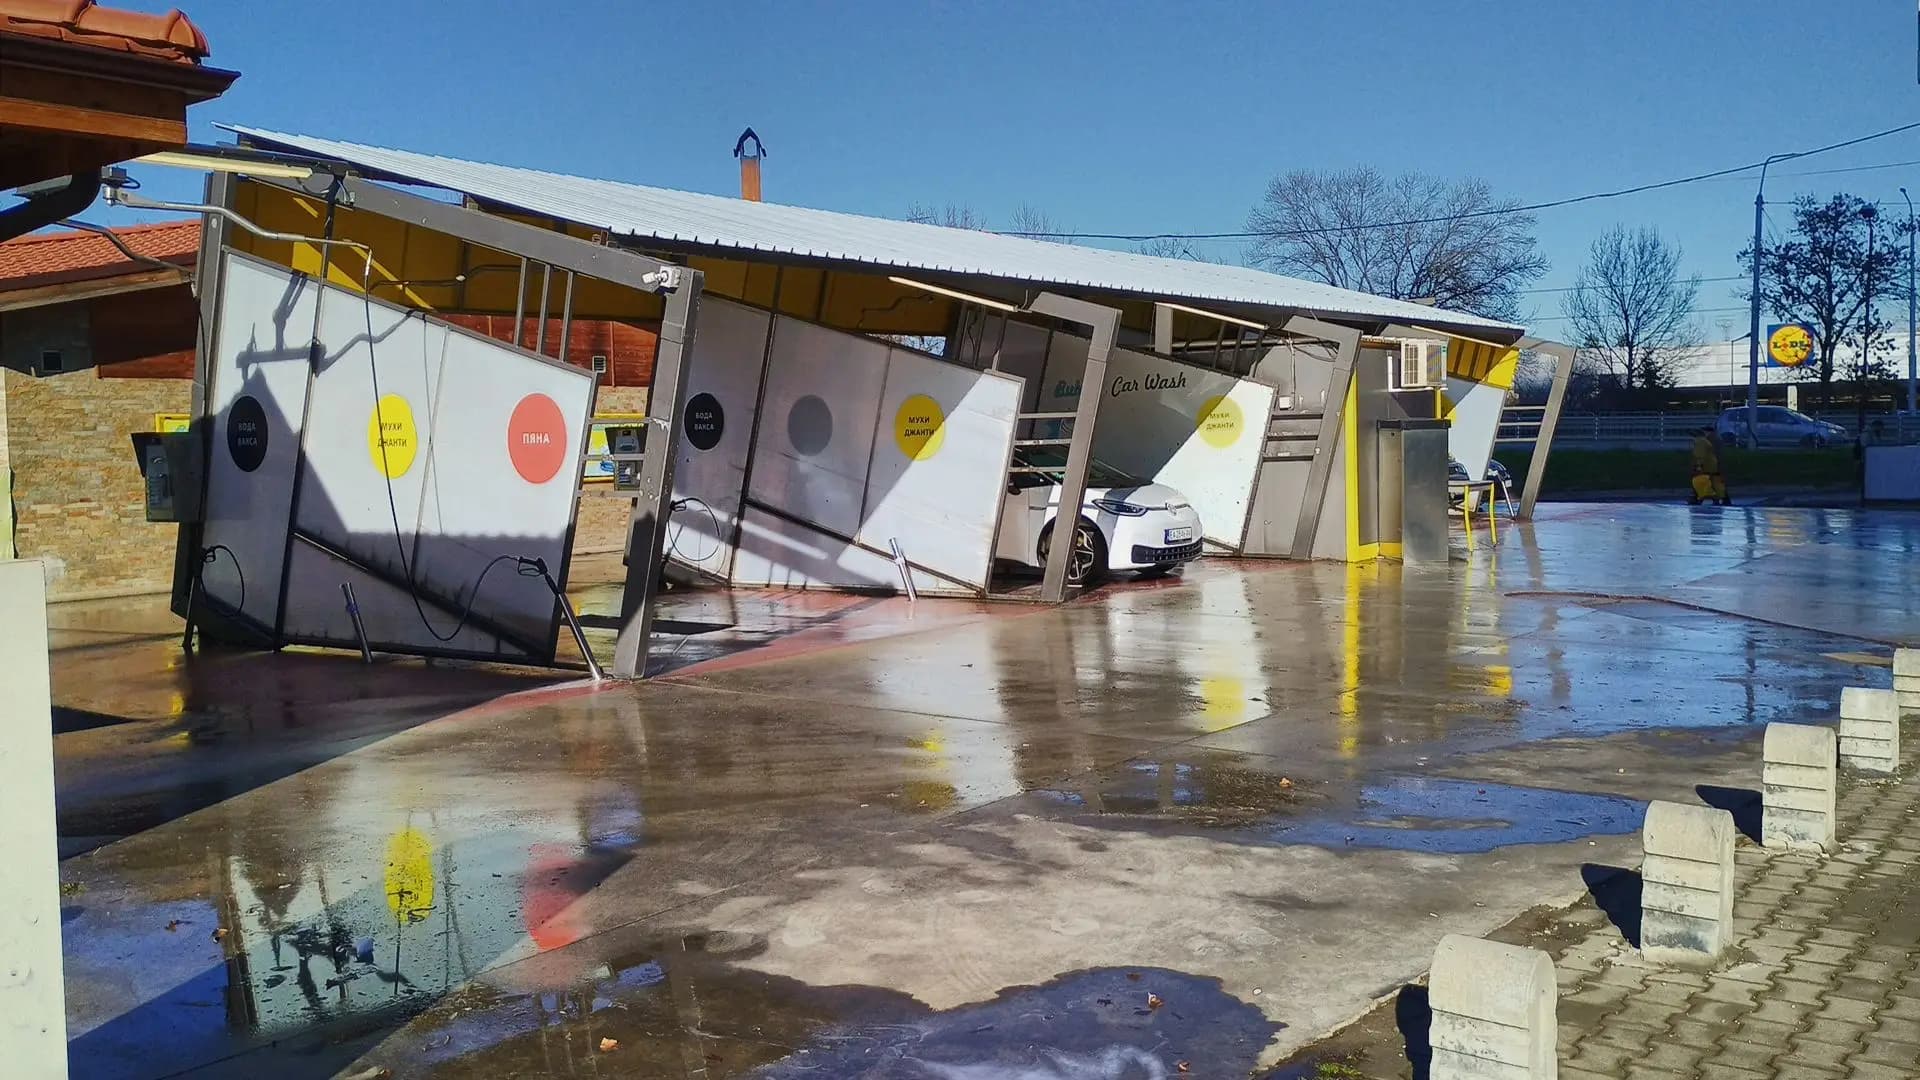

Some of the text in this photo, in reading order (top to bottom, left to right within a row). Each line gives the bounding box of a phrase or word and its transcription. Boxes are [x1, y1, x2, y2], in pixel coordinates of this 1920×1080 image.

[1112, 376, 1139, 397] Car
[1144, 372, 1186, 390] Wash
[908, 416, 930, 424] МУХИ
[522, 432, 551, 445] ПЯНА
[904, 428, 935, 438] ДЖАНТИ
